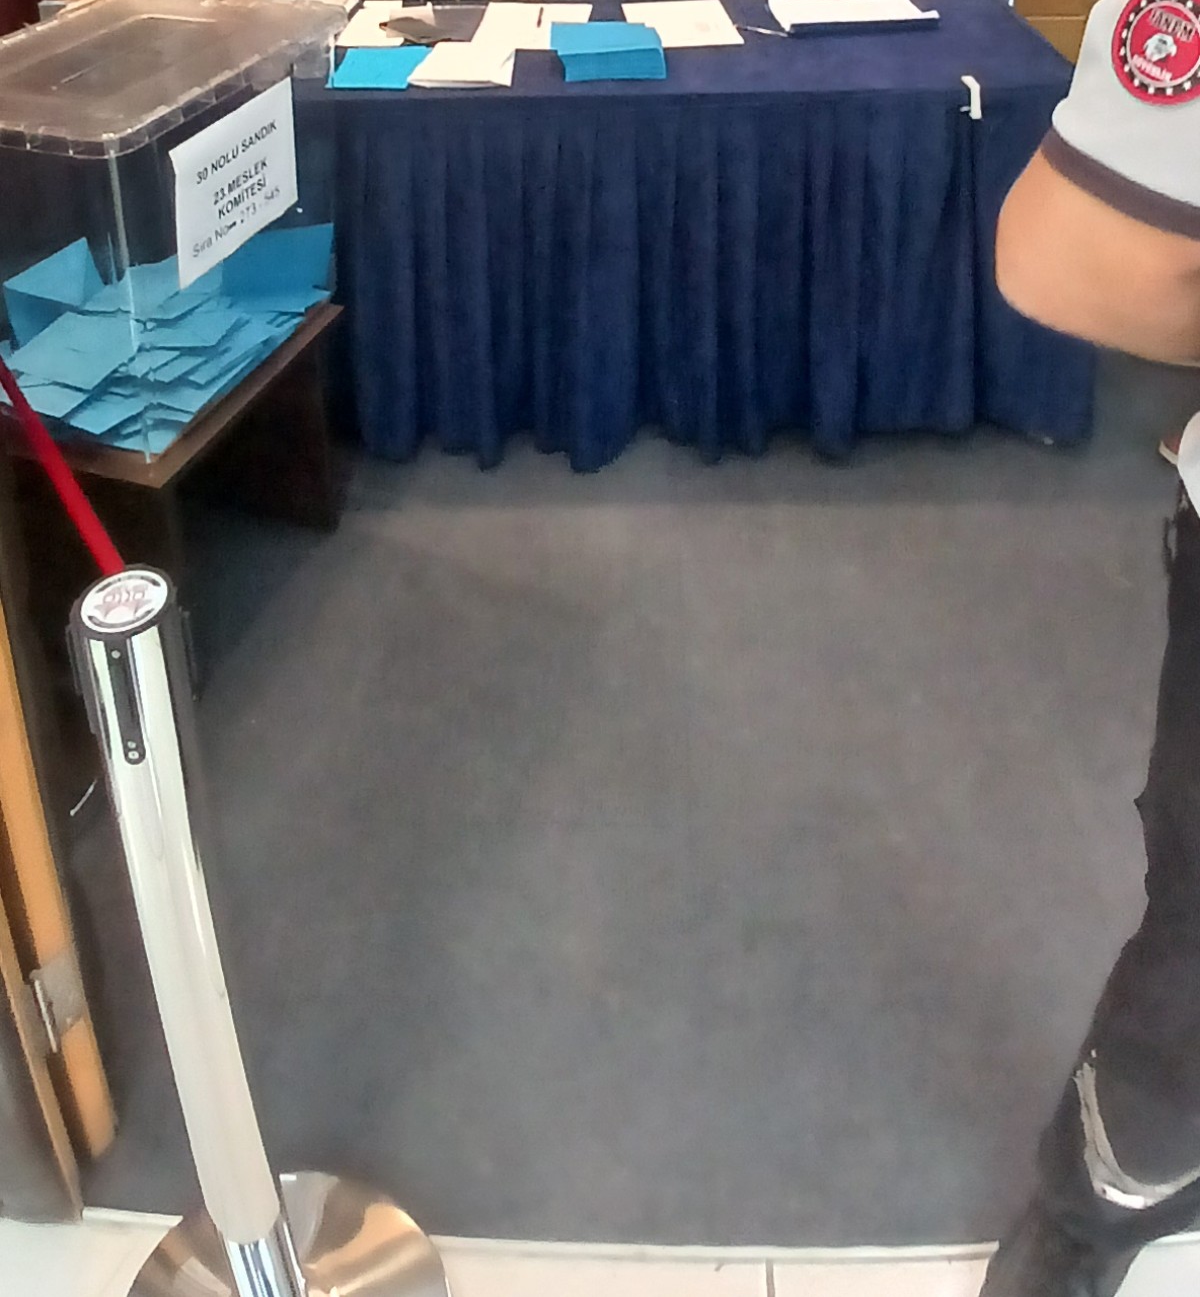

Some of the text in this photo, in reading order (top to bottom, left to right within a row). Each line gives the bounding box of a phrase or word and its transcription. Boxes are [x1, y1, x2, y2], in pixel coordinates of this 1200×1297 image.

[210, 144, 240, 175] NOLU
[241, 118, 278, 153] SANDIK
[218, 173, 267, 220] KOMİTESİ
